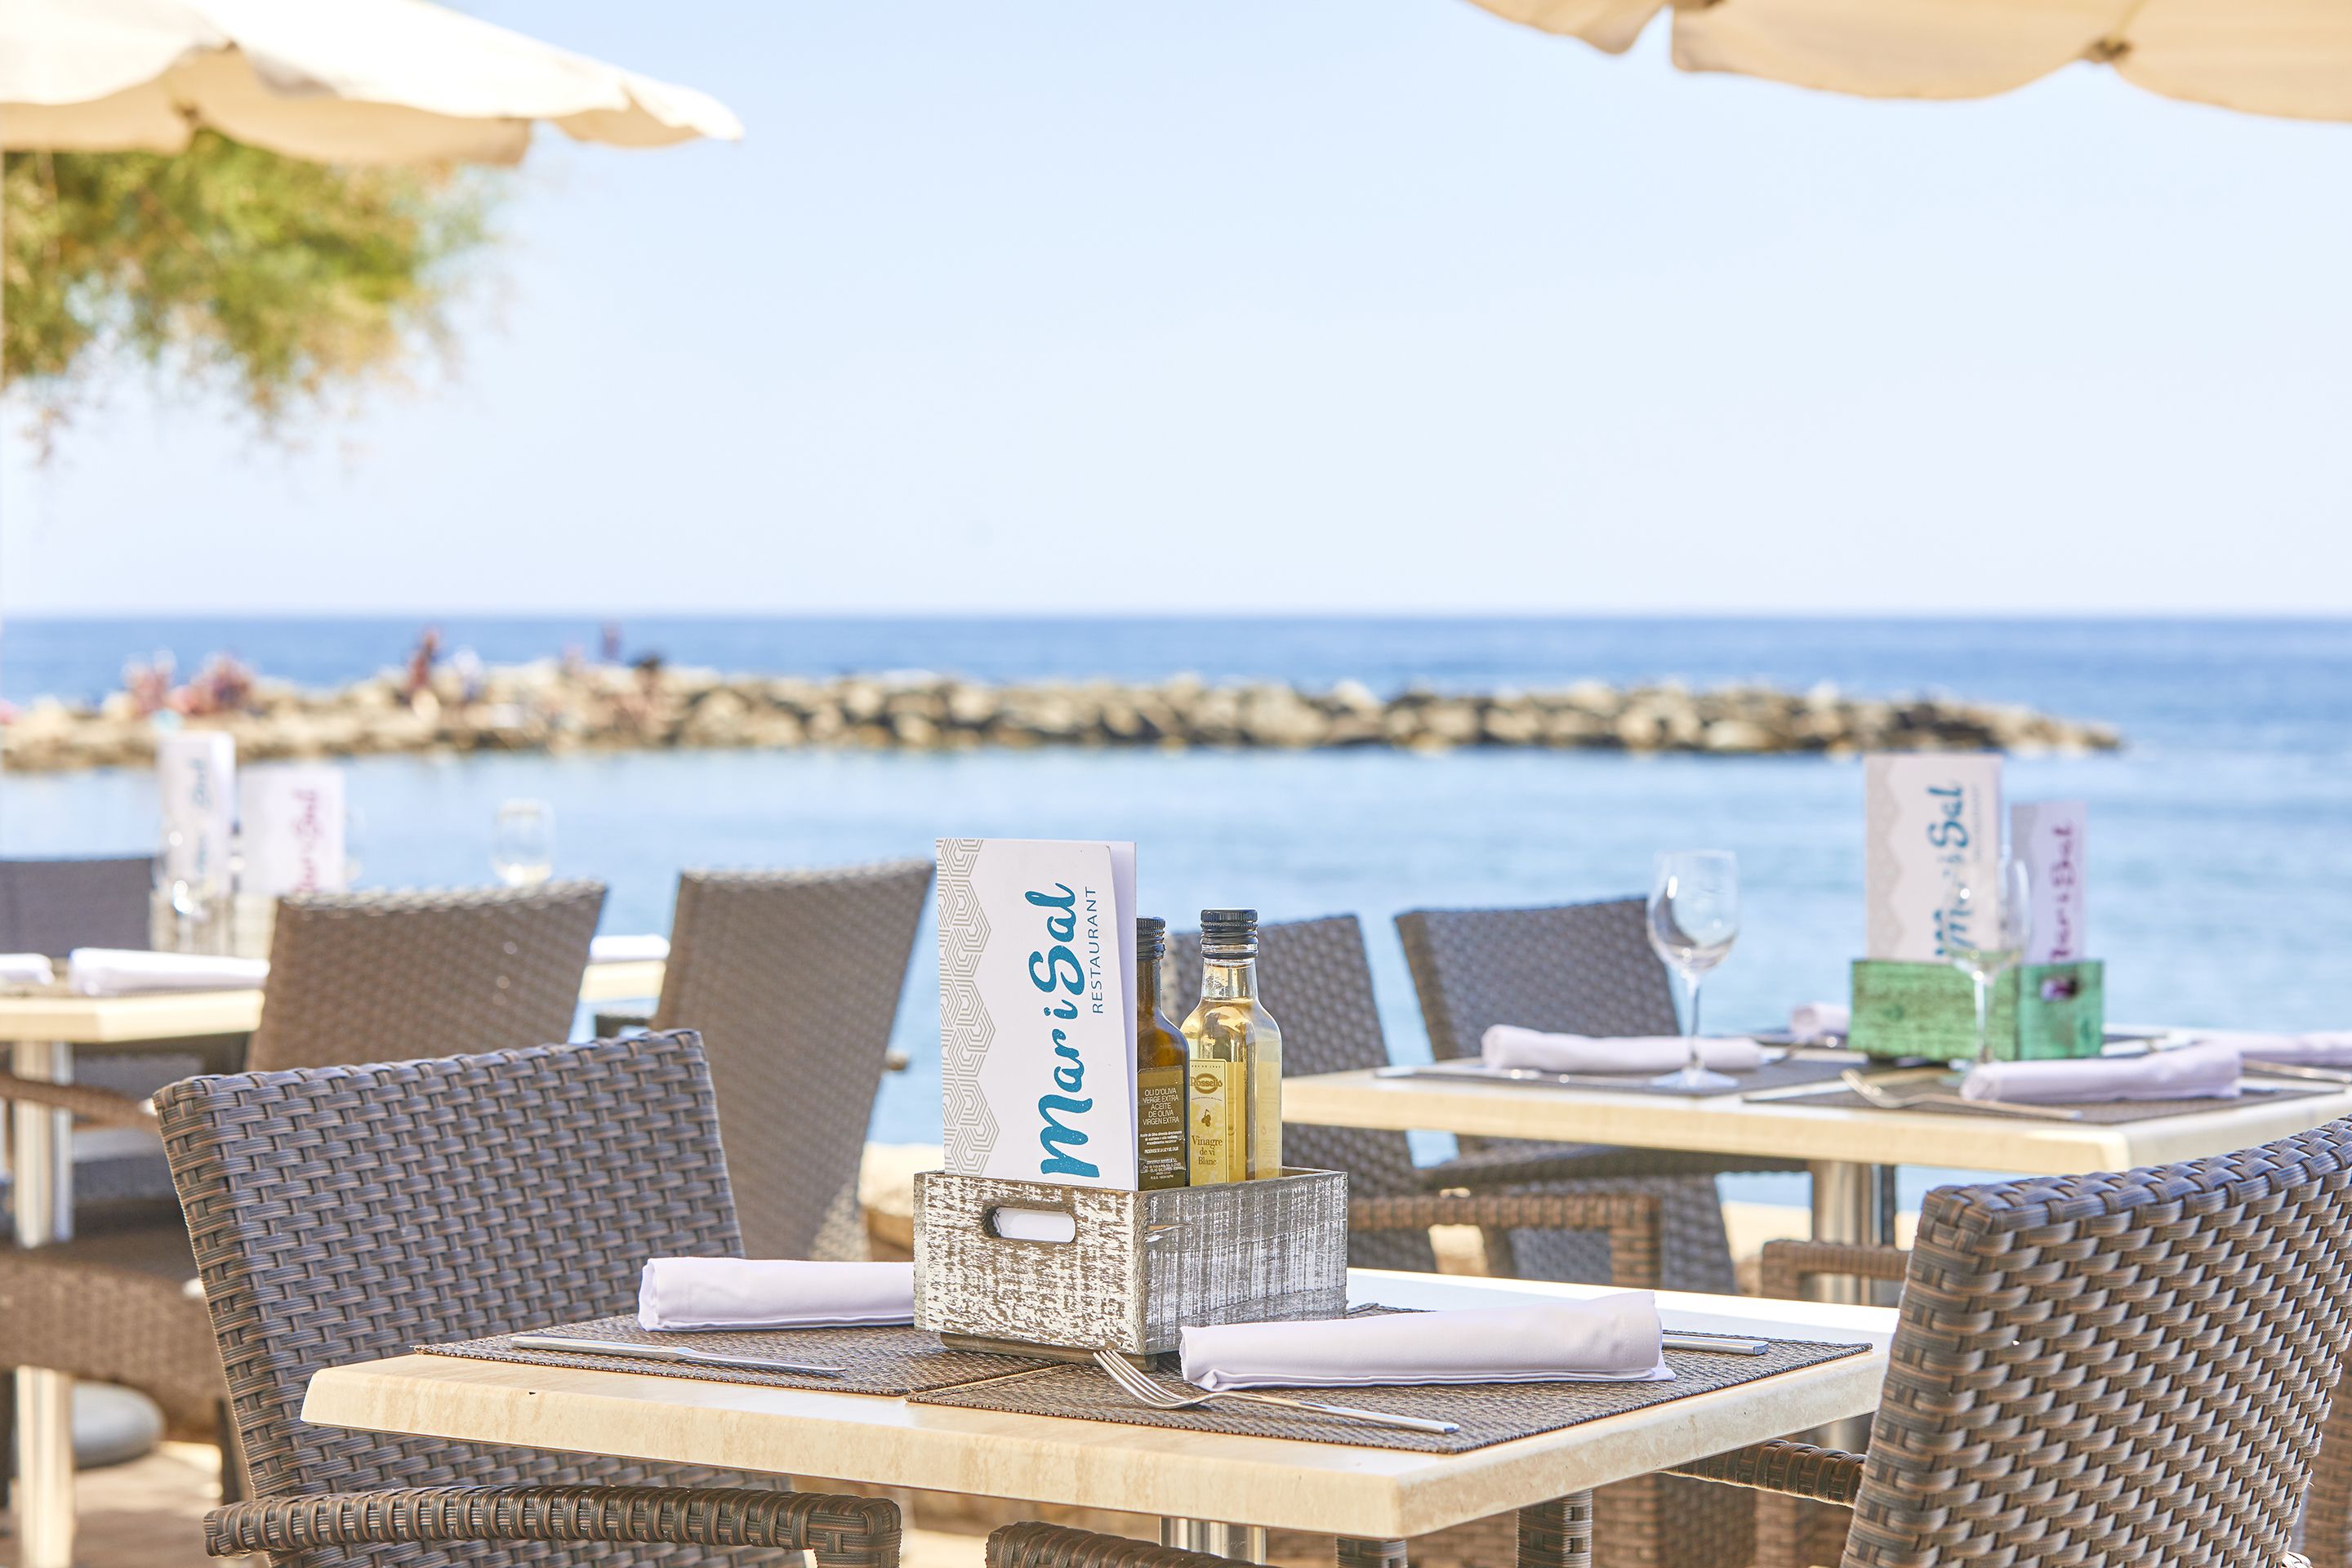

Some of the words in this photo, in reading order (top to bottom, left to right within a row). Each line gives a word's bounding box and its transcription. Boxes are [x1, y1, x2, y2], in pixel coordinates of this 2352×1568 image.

[1085, 886, 1104, 1014] RESTAURANT
[1144, 1089, 1154, 1097] OLI
[1155, 1087, 1177, 1096] D'OLIVA
[1143, 1096, 1161, 1104] VERGE
[1161, 1094, 1179, 1102] EXTRA
[1150, 1102, 1172, 1111] ACEITE
[1157, 1109, 1174, 1117] OLIVA
[1143, 1117, 1162, 1125] VIRGEN
[1163, 1116, 1180, 1125] EXTRA
[1192, 1135, 1223, 1150] Vinagre
[1199, 1147, 1208, 1156] de
[1198, 1156, 1217, 1165] Blanc
